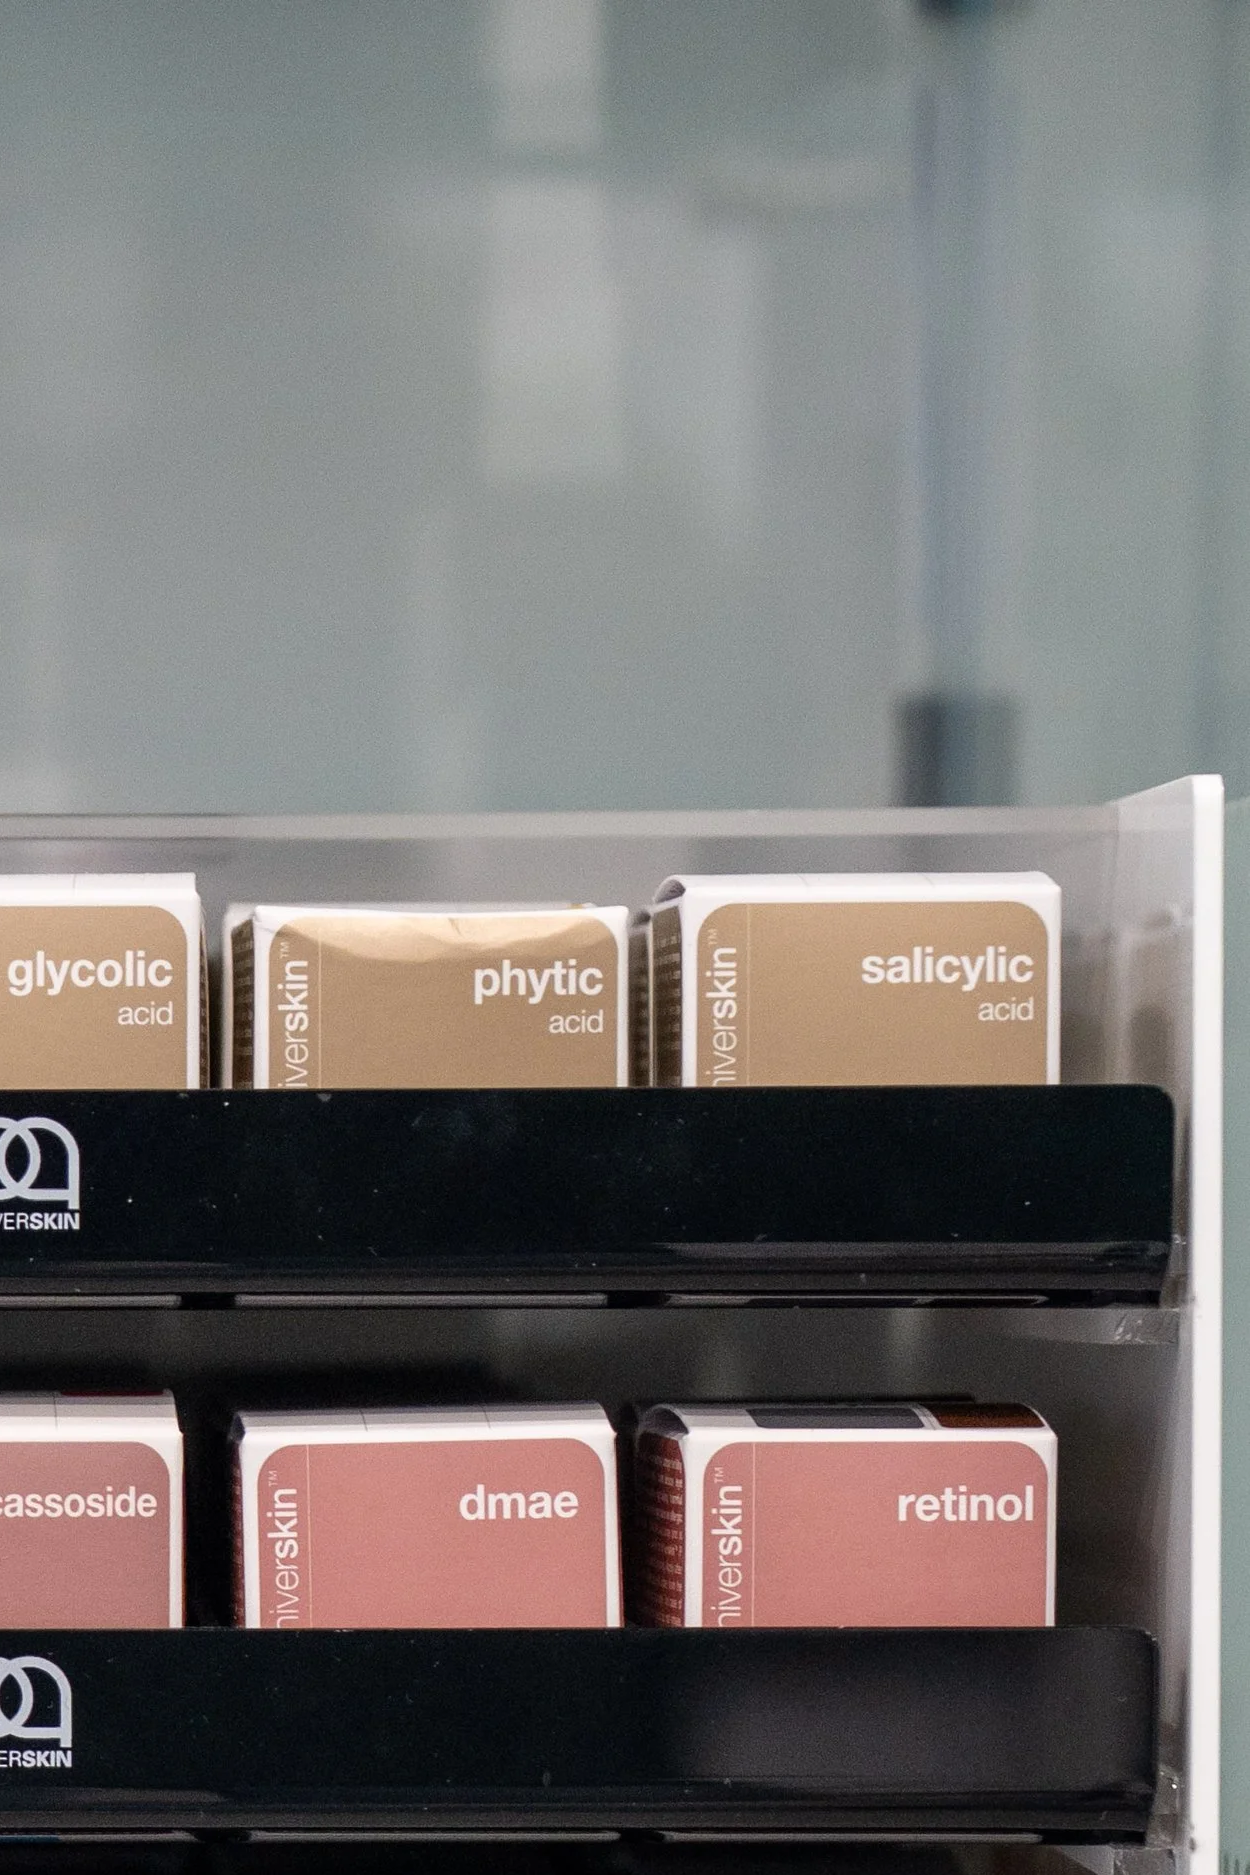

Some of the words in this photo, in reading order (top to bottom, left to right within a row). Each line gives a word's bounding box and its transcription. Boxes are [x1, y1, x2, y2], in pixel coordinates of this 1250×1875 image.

[7, 950, 173, 996] glycolic
[474, 959, 603, 1004] phytic
[861, 945, 1034, 991] salicylic
[118, 1001, 173, 1025] acid
[549, 1009, 603, 1033] acid
[978, 997, 1034, 1021] acid
[459, 1484, 579, 1520] dmae
[897, 1485, 1034, 1522] retinol
